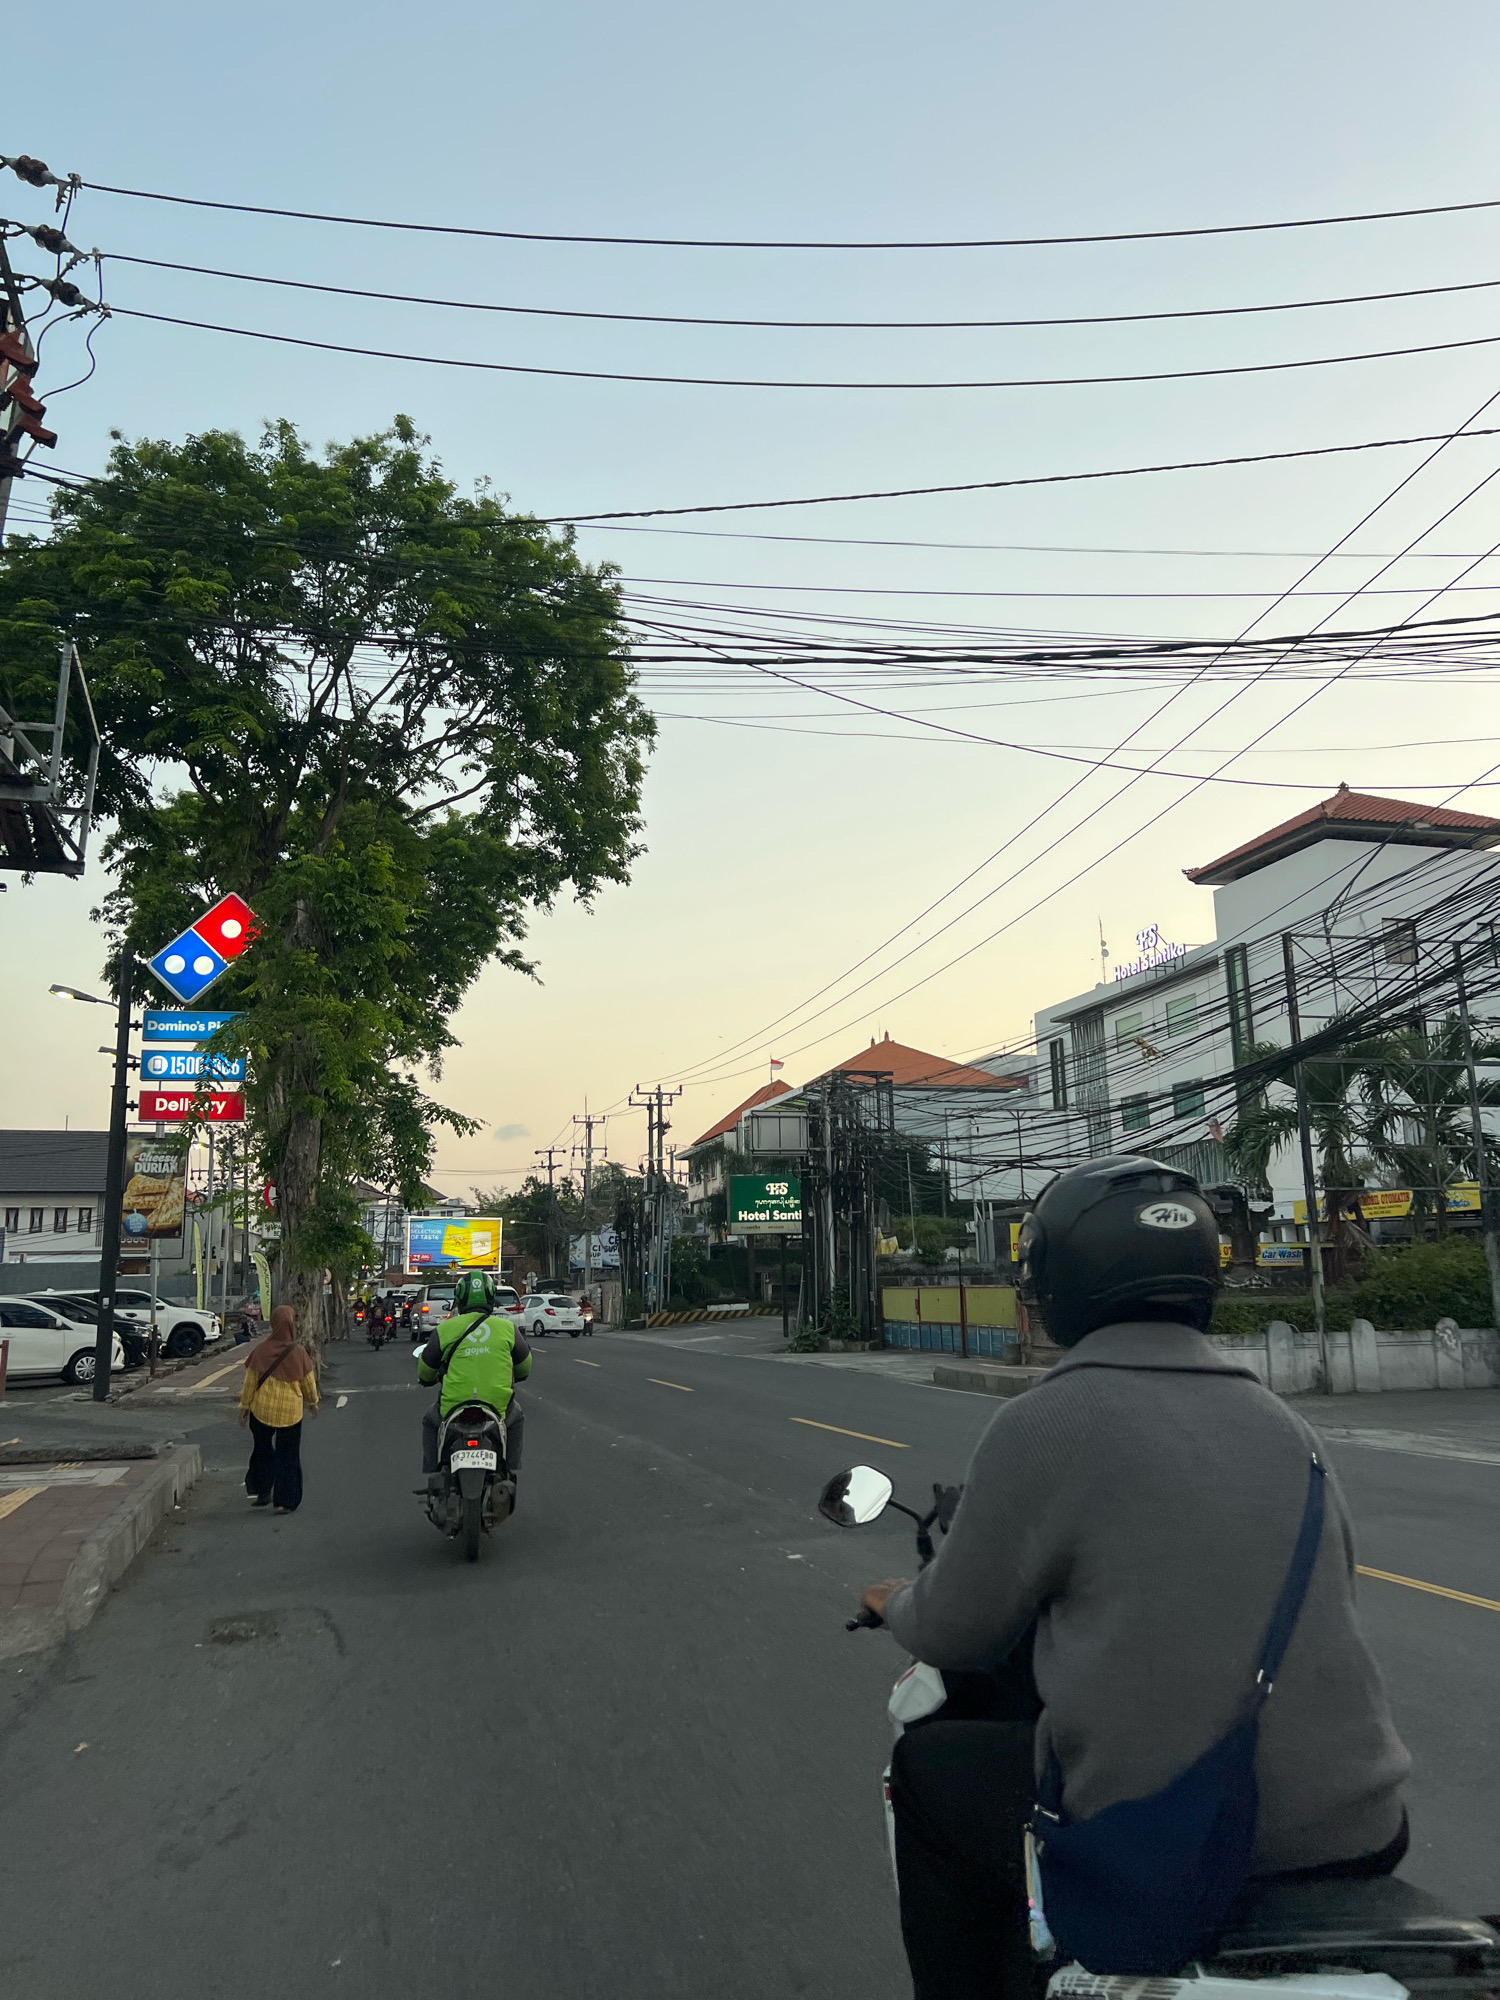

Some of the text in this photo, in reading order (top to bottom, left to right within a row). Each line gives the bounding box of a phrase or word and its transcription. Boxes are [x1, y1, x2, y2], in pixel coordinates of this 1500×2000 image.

[1113, 943, 1186, 982] Hotel Santika
[147, 1020, 205, 1032] Domino's
[138, 1152, 178, 1163] Cheesy
[134, 1162, 178, 1173] DURIAN
[738, 1210, 802, 1221] Hotel Santi
[1262, 1250, 1302, 1258] Car Wash
[464, 1345, 490, 1356] gojek
[461, 1451, 479, 1459] 3744
